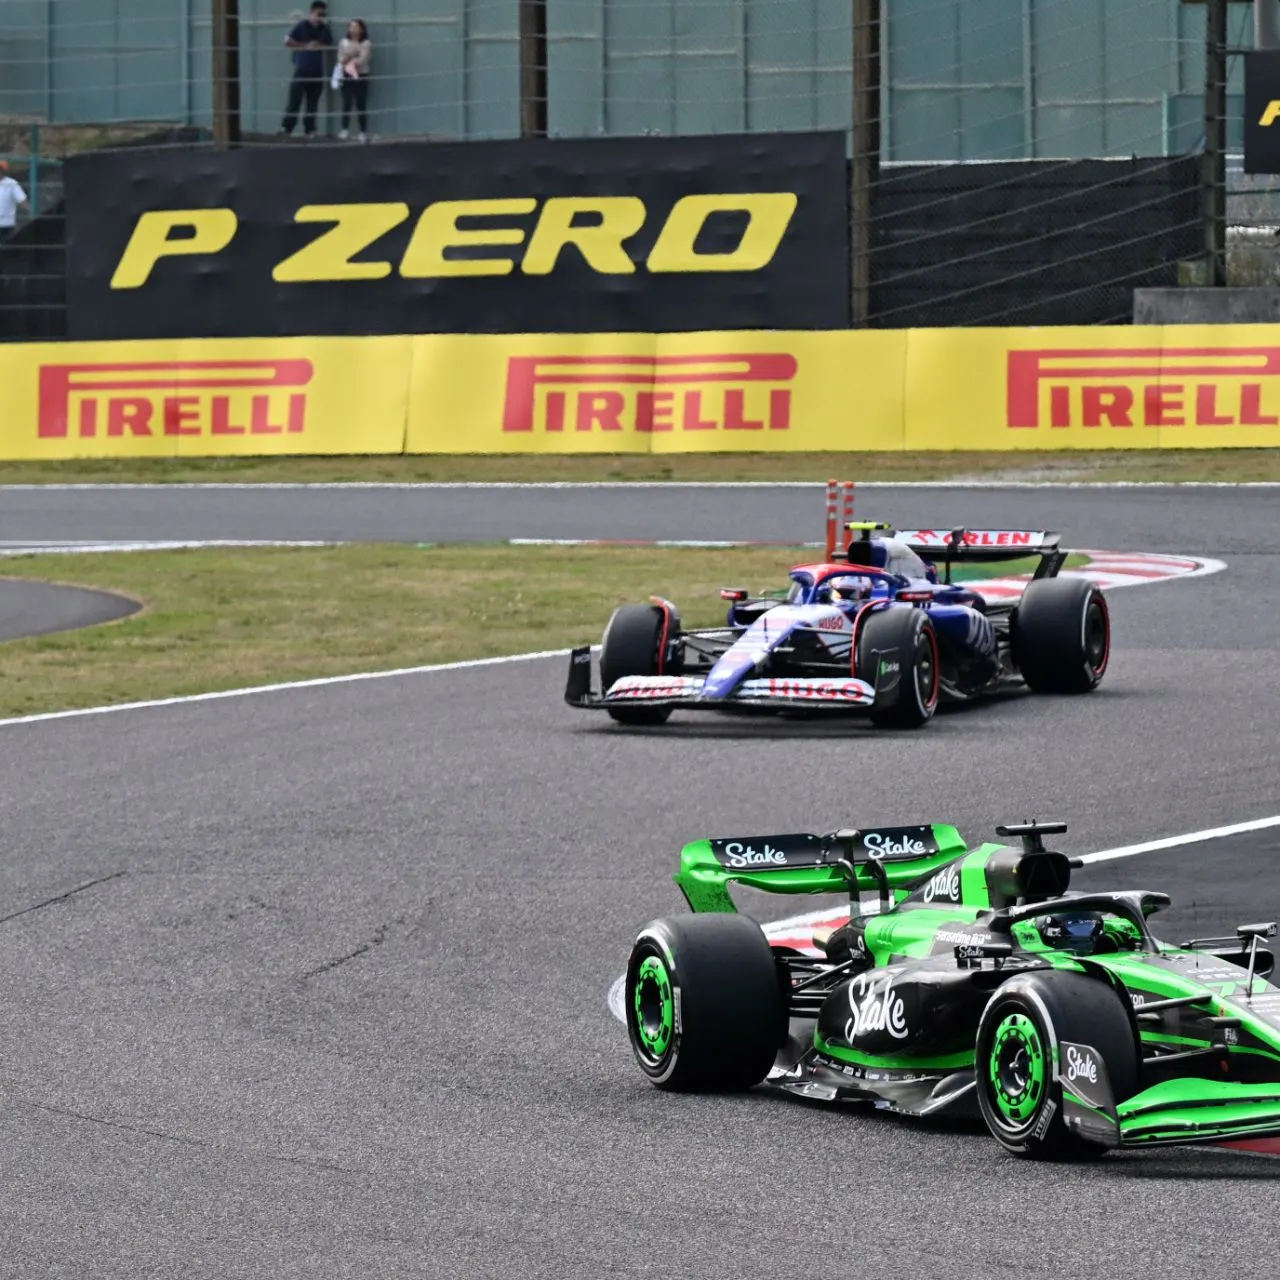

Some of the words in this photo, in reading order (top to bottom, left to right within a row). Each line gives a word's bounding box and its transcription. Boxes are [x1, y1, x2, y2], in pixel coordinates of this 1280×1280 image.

[109, 208, 238, 290] P
[271, 192, 798, 283] ZERO
[38, 359, 314, 438] PIRELLI
[502, 353, 798, 432] PIRELLI
[818, 616, 844, 630] HUGO
[768, 678, 865, 701] HUGO
[725, 843, 788, 868] Stake
[863, 833, 927, 860] Stake
[923, 864, 960, 904] Stake
[958, 945, 985, 959] Stake
[845, 973, 909, 1045] Stake
[1067, 1046, 1098, 1084] Stake
